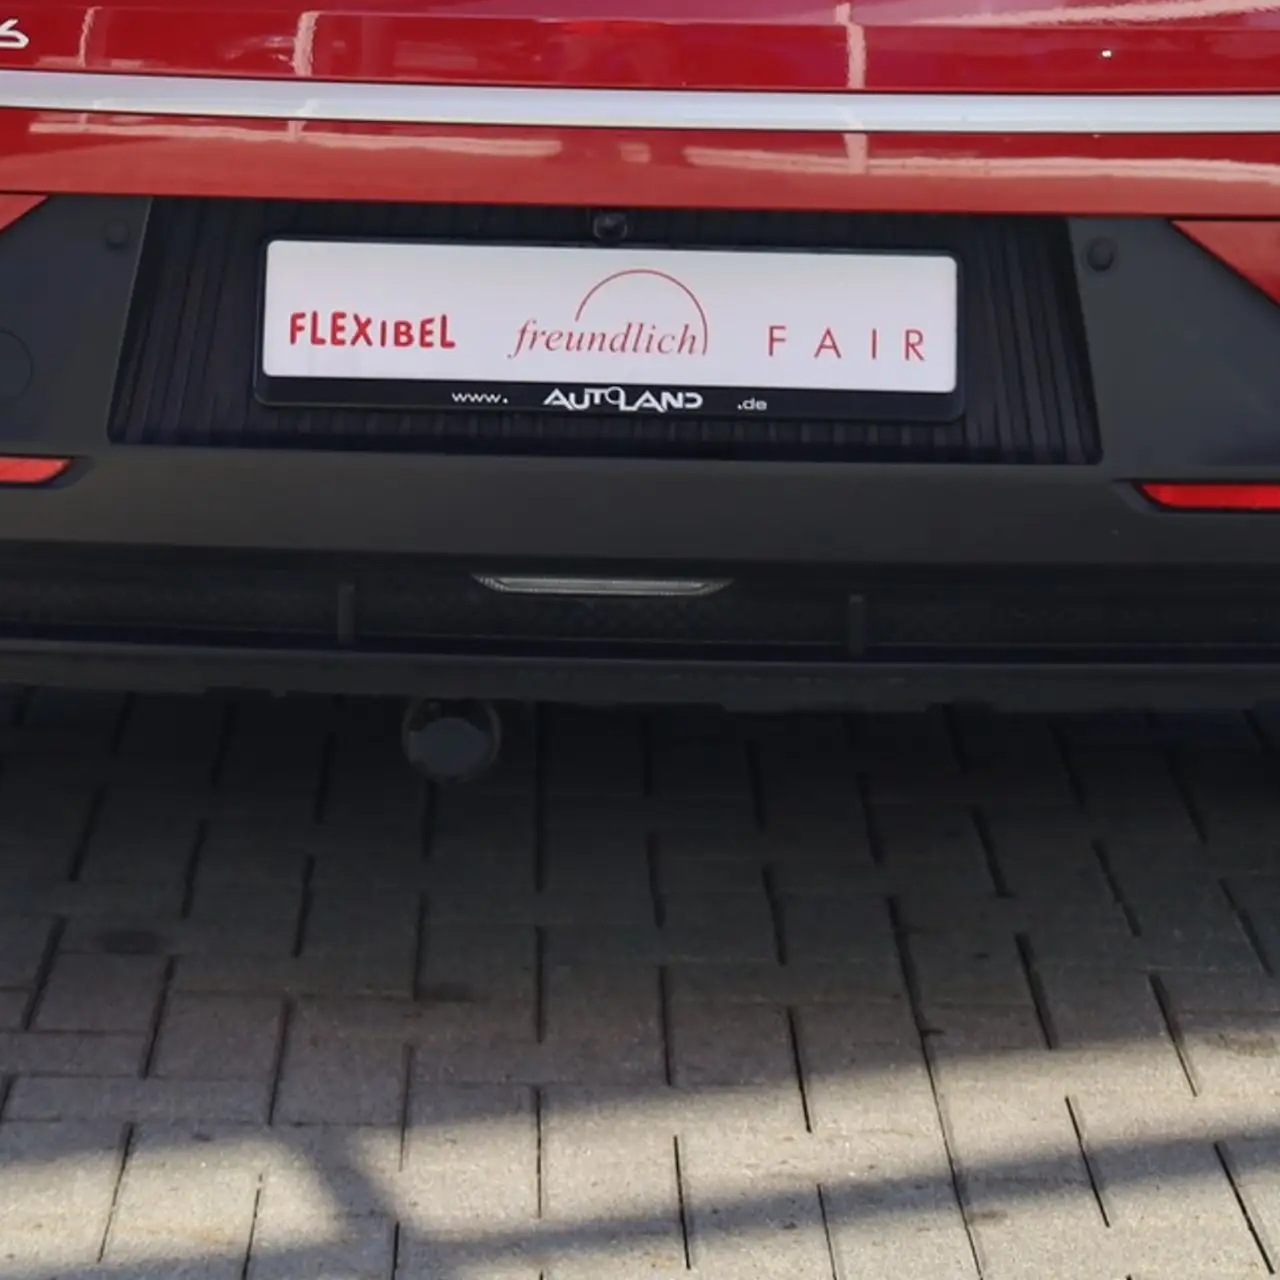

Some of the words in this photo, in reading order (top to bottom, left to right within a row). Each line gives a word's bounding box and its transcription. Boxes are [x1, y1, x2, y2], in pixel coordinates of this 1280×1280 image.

[289, 311, 456, 349] FLEXIBEL
[507, 318, 698, 360] freundlich
[768, 325, 925, 361] FAIR
[451, 391, 509, 404] www.
[736, 398, 769, 412] .de
